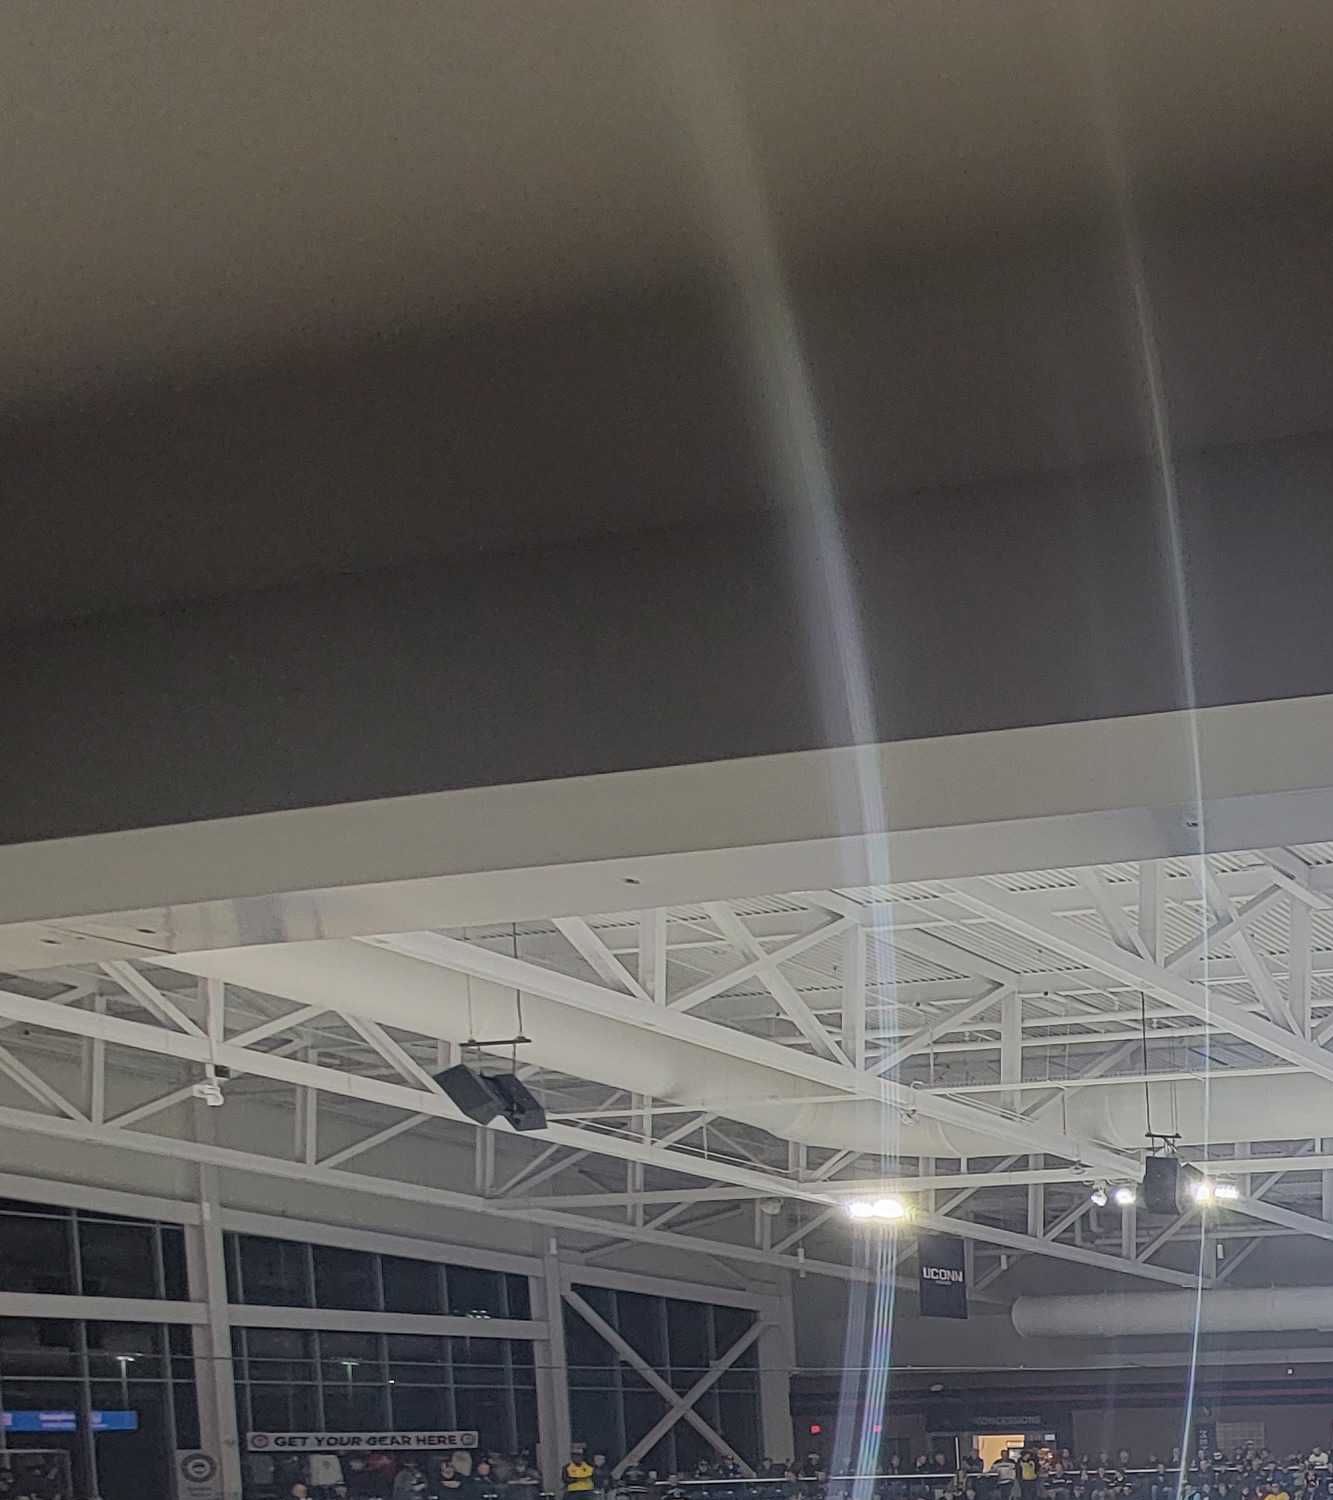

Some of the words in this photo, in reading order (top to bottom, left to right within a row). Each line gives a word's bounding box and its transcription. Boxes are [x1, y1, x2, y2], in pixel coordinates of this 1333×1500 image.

[923, 1267, 962, 1282] UCONN
[274, 1436, 308, 1447] GET
[316, 1436, 364, 1447] YOUR
[366, 1435, 411, 1446] GEAR
[416, 1434, 457, 1446] HERE
